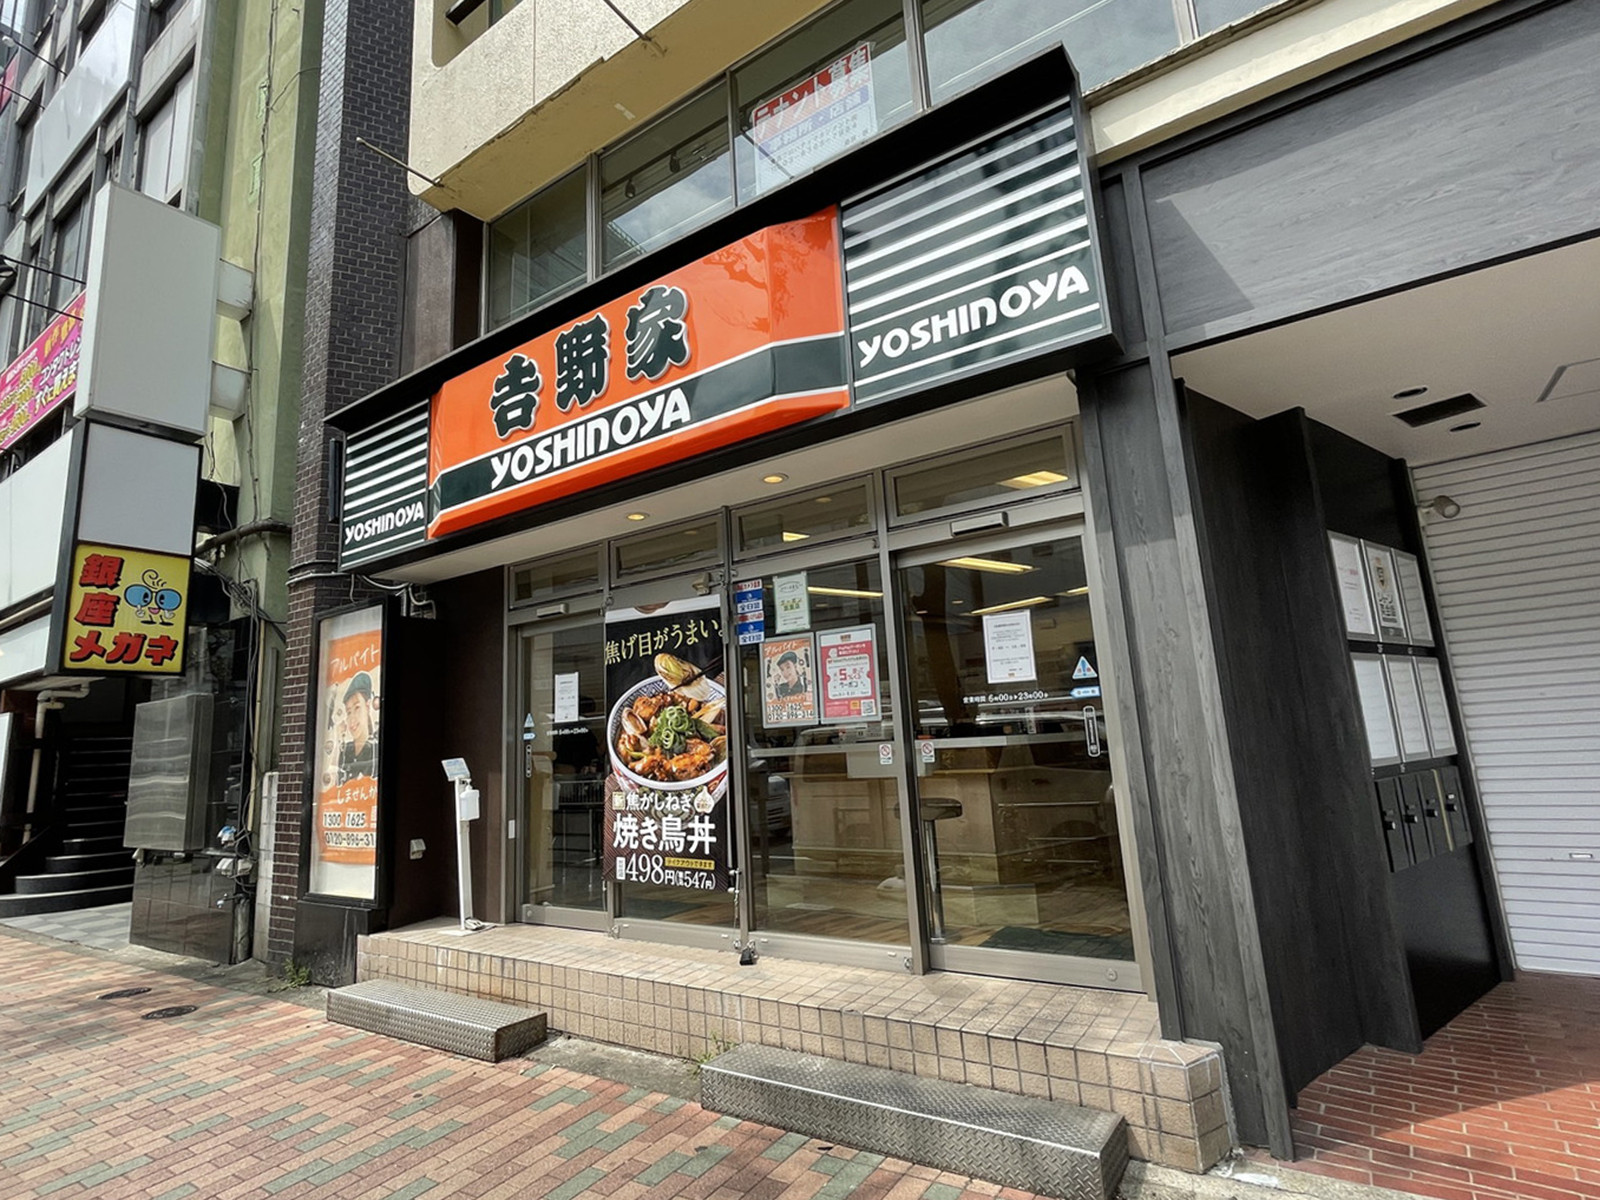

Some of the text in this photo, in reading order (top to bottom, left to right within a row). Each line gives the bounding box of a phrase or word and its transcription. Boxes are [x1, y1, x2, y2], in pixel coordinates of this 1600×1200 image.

[756, 46, 868, 139] テナント募集
[857, 265, 1090, 369] YOSHINOYA
[489, 284, 693, 440] 吉野家
[490, 387, 692, 491] YOSHINOYA
[344, 500, 425, 545] YOSHINOYA
[75, 553, 125, 627] 銀座
[69, 630, 179, 666] メガネ
[331, 643, 380, 677] アルバイト
[346, 812, 366, 827] 1625
[626, 791, 695, 812] 焦がしねぎ
[613, 813, 717, 855] 焼き鳥丼
